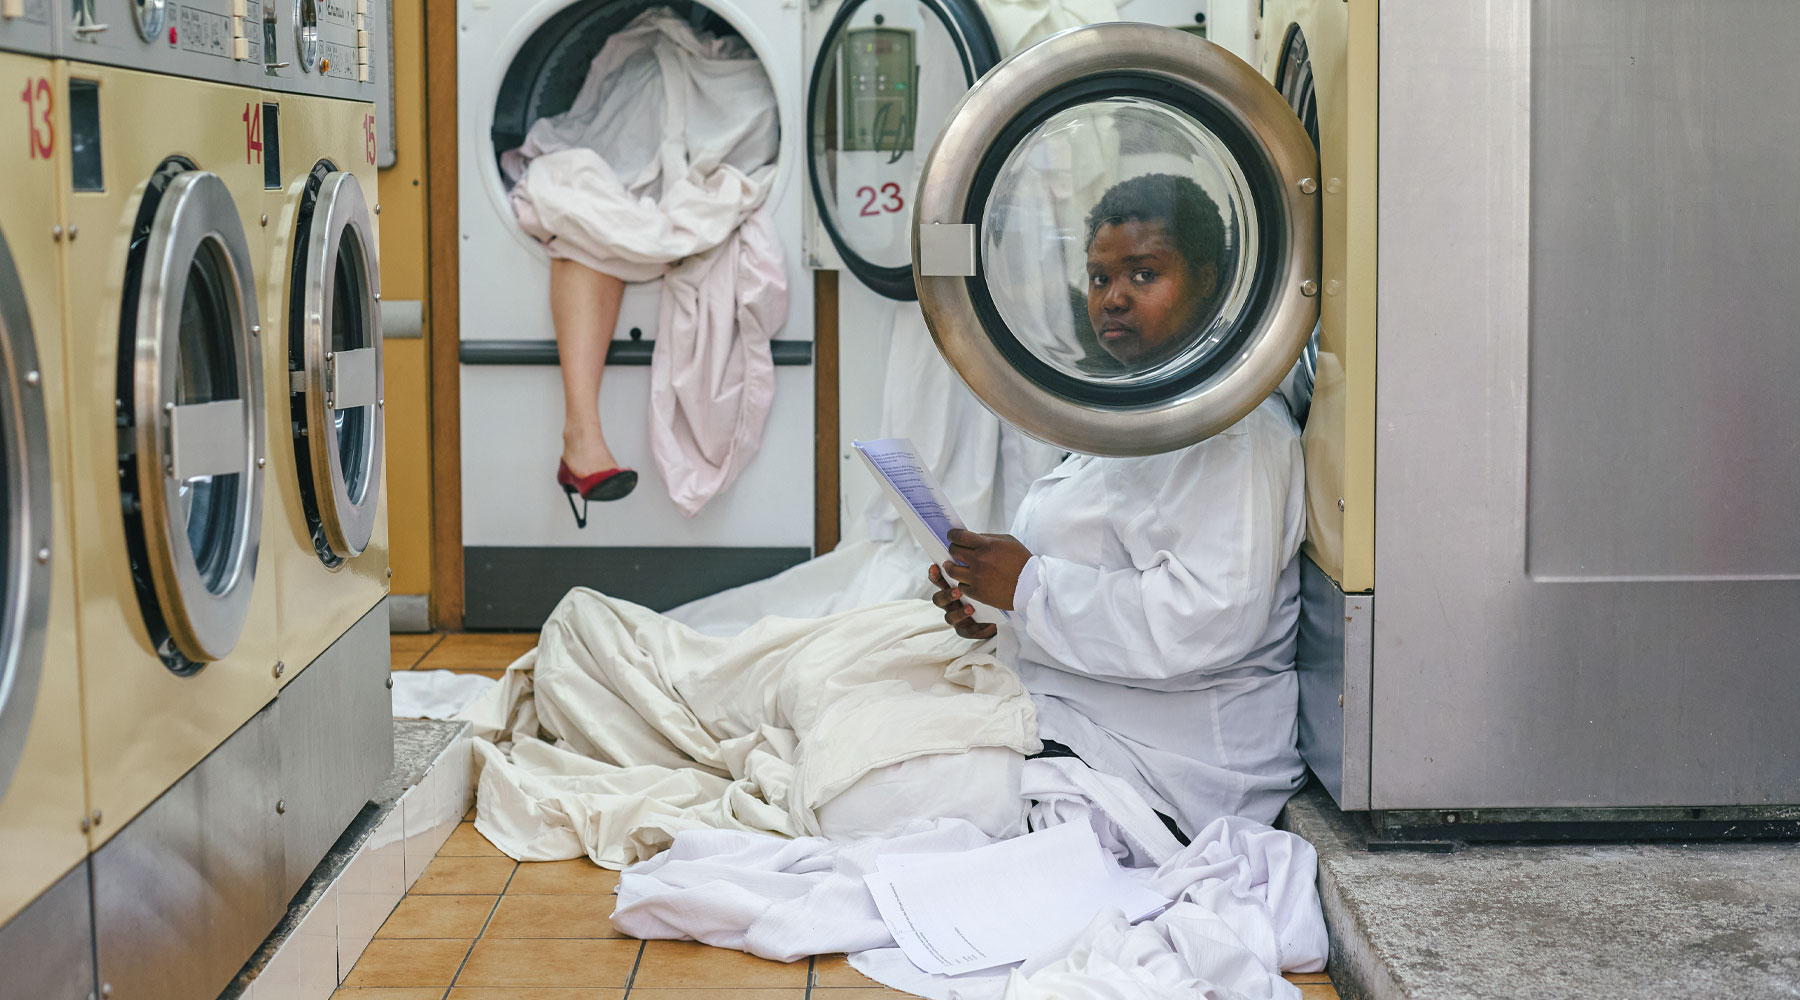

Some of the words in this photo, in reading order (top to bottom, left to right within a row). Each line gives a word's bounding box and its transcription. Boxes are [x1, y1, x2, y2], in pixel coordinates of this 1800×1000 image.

[22, 78, 54, 159] 13
[242, 103, 263, 164] 14
[363, 113, 376, 165] 15
[856, 182, 904, 217] 23
